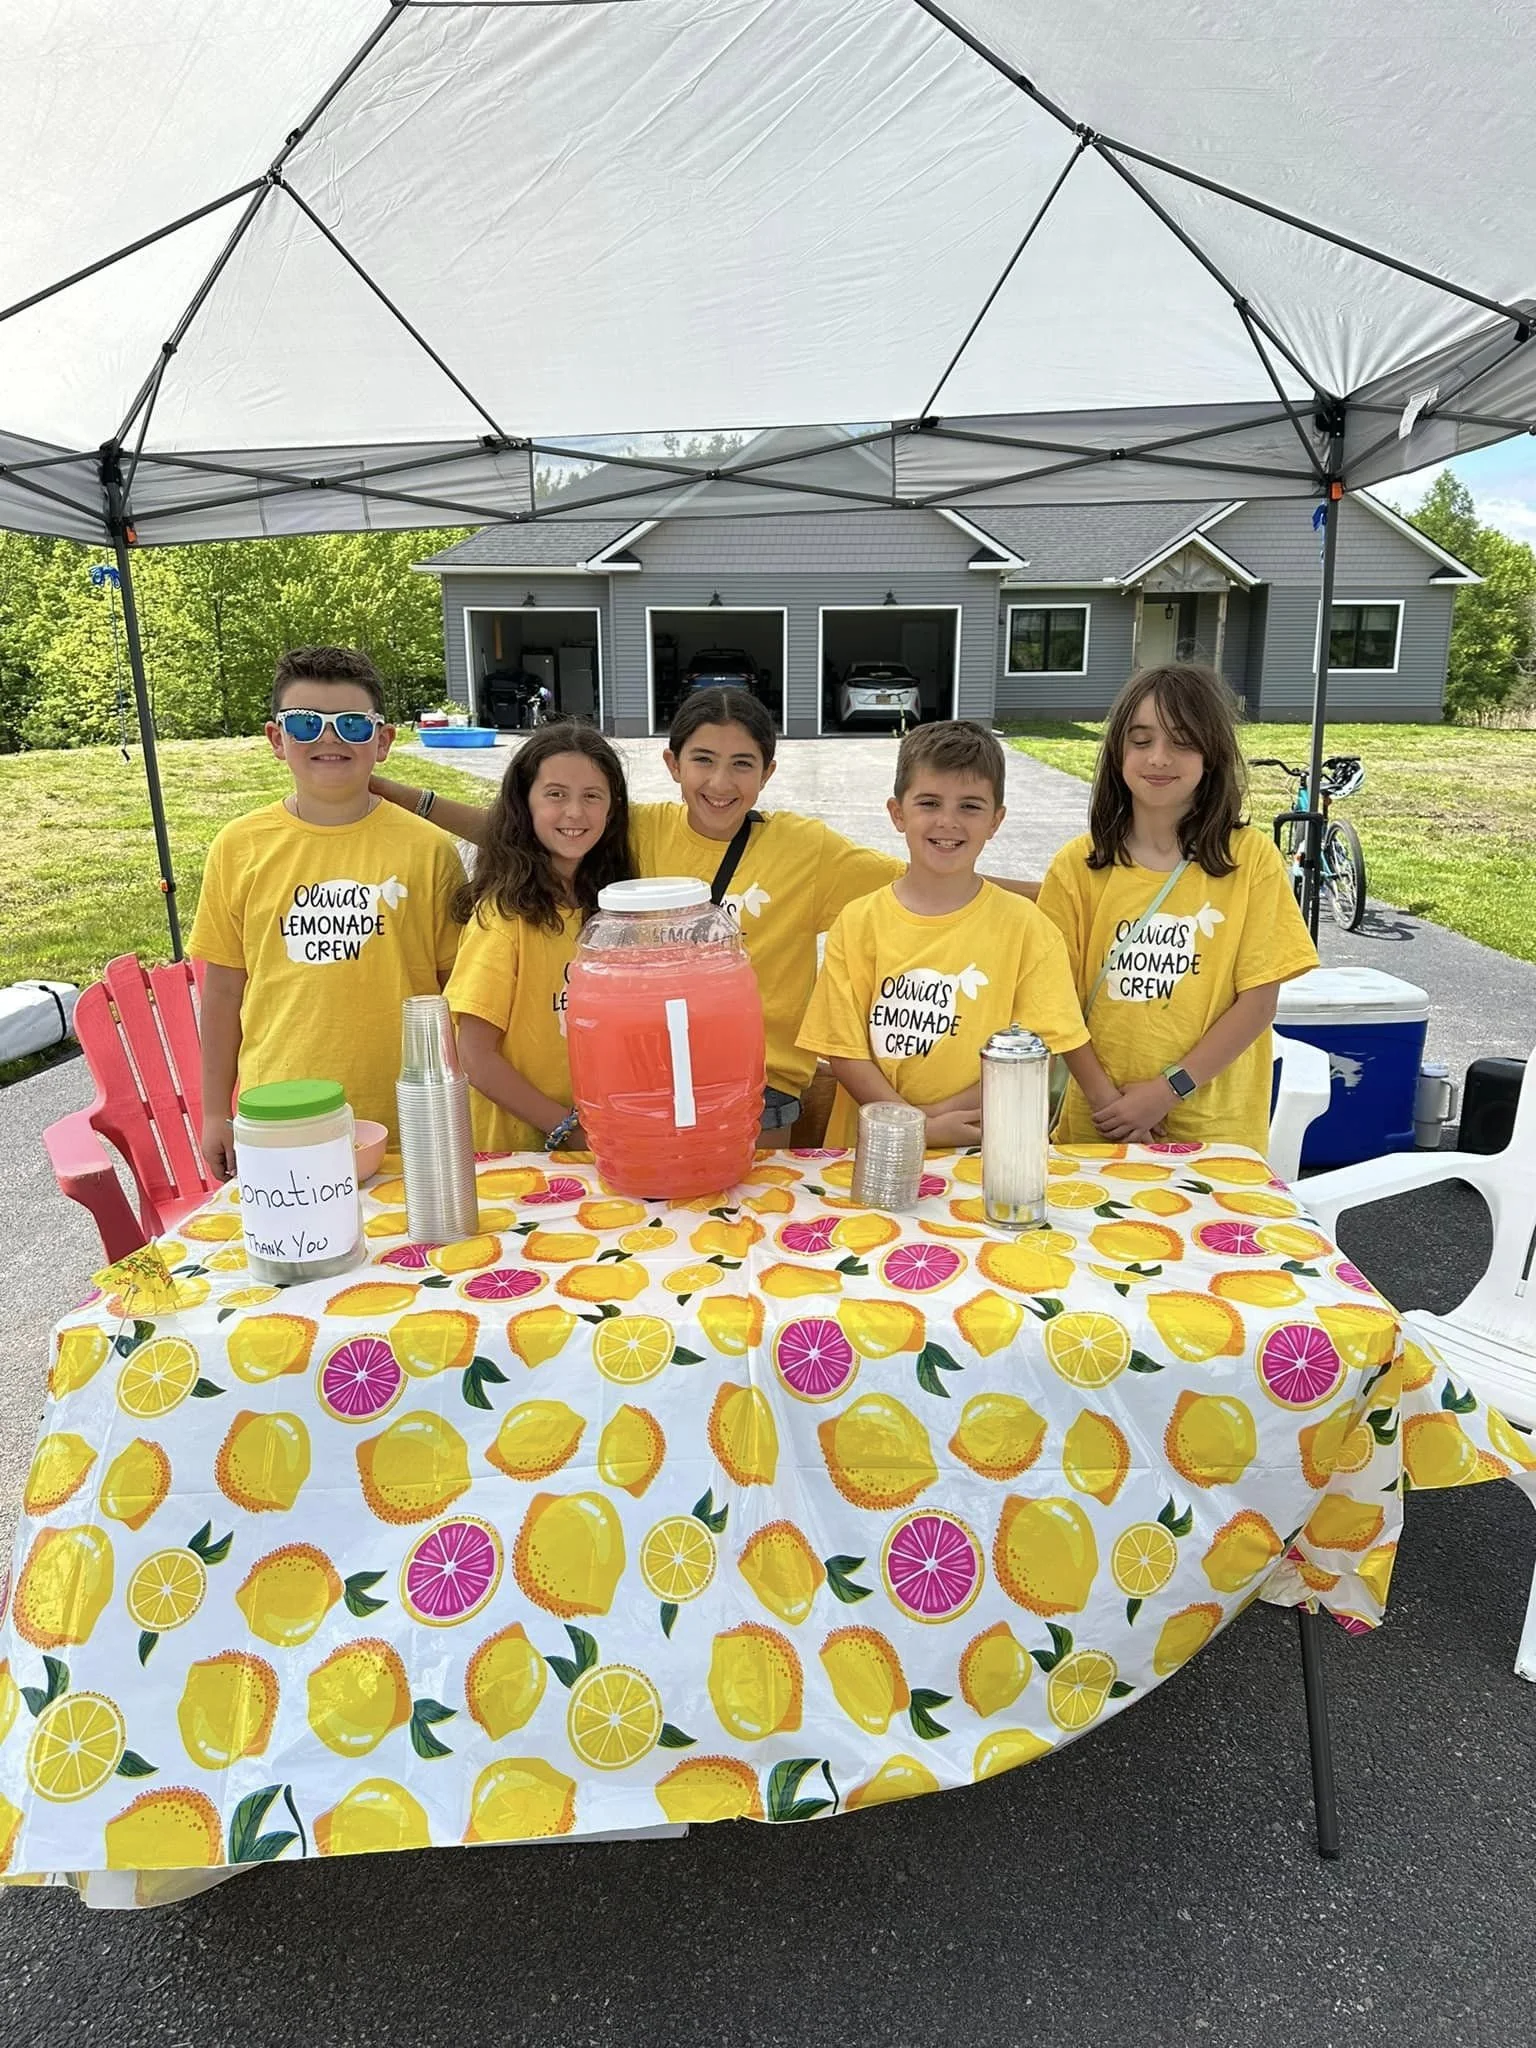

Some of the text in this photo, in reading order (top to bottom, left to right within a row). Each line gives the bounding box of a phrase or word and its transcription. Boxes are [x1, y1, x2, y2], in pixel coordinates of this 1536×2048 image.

[294, 883, 370, 910] Olivia's
[279, 914, 385, 937] LEMONADE
[305, 940, 361, 961] CREW
[880, 974, 953, 1009] Olivia's
[1119, 976, 1175, 1000] CREW
[869, 1005, 963, 1037] EMONADE
[885, 1033, 934, 1058] CREW
[239, 1170, 353, 1208] onations
